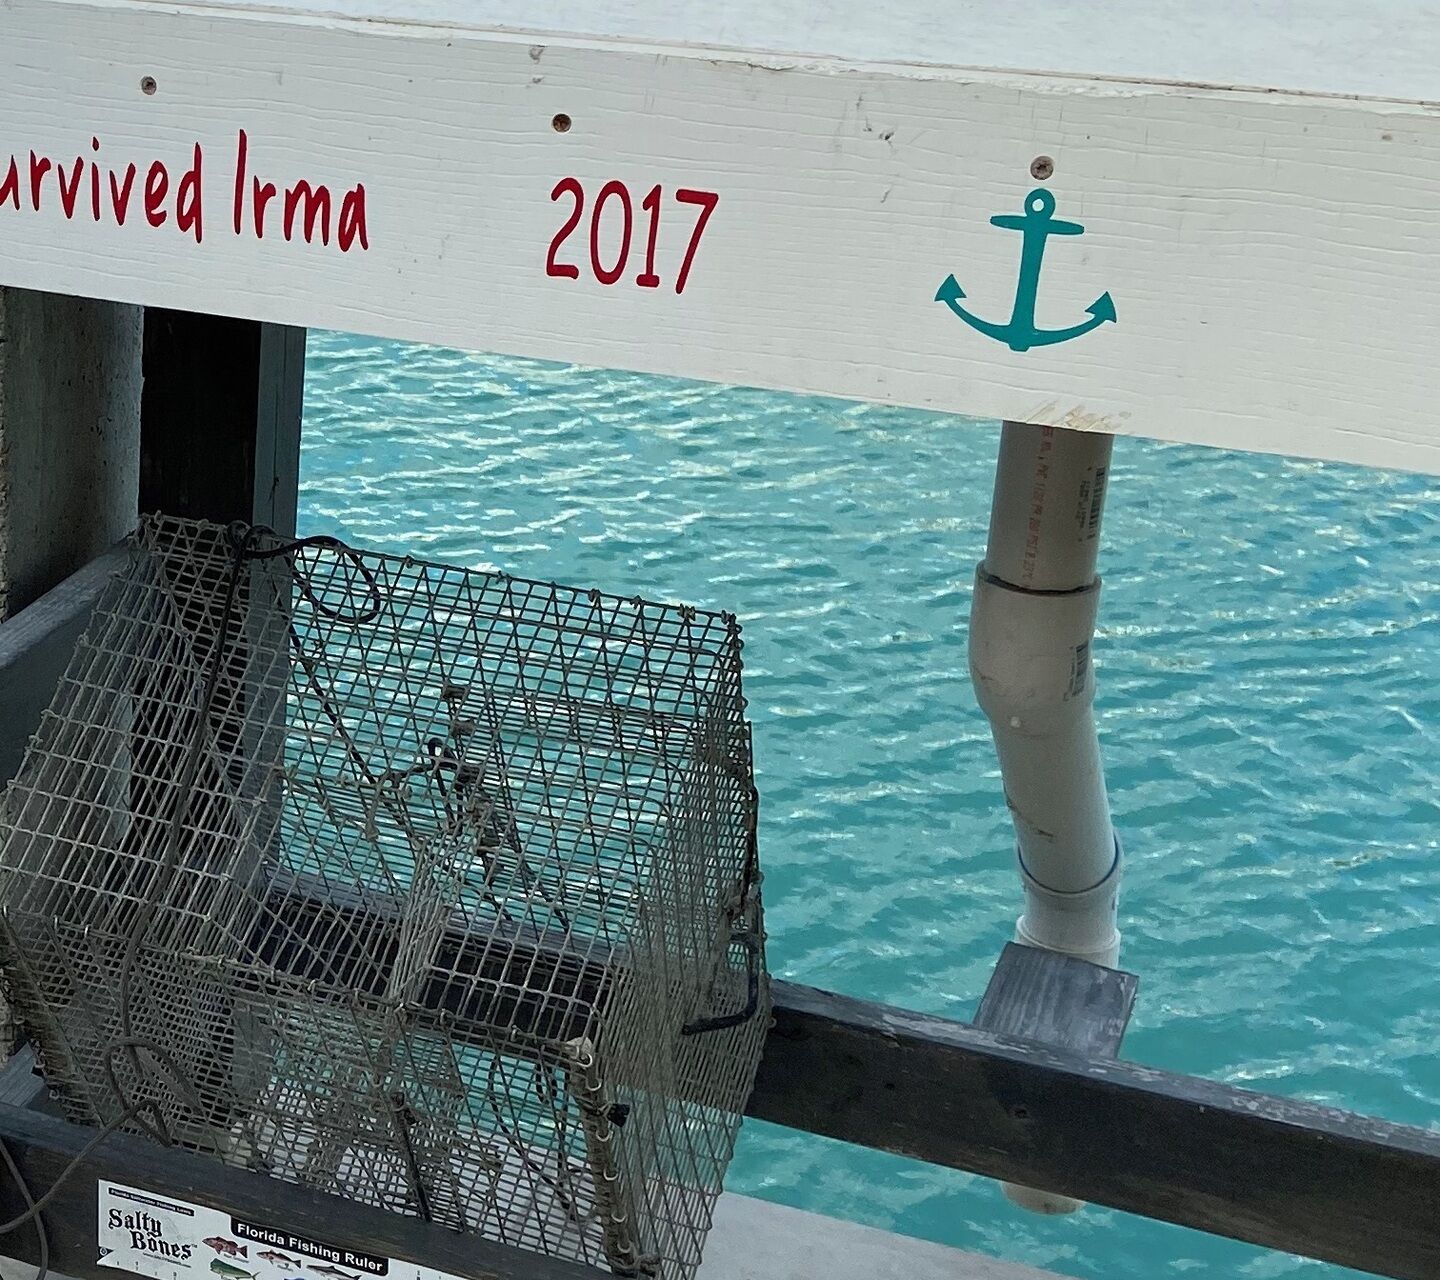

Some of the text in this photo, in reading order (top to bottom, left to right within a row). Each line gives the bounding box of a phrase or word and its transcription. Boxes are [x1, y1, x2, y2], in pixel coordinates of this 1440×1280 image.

[233, 128, 369, 252] Irma
[546, 177, 719, 295] 2017
[108, 1208, 162, 1238] Salty
[130, 1230, 192, 1260] Bones
[237, 1222, 384, 1272] Florida Fishing Ruler
